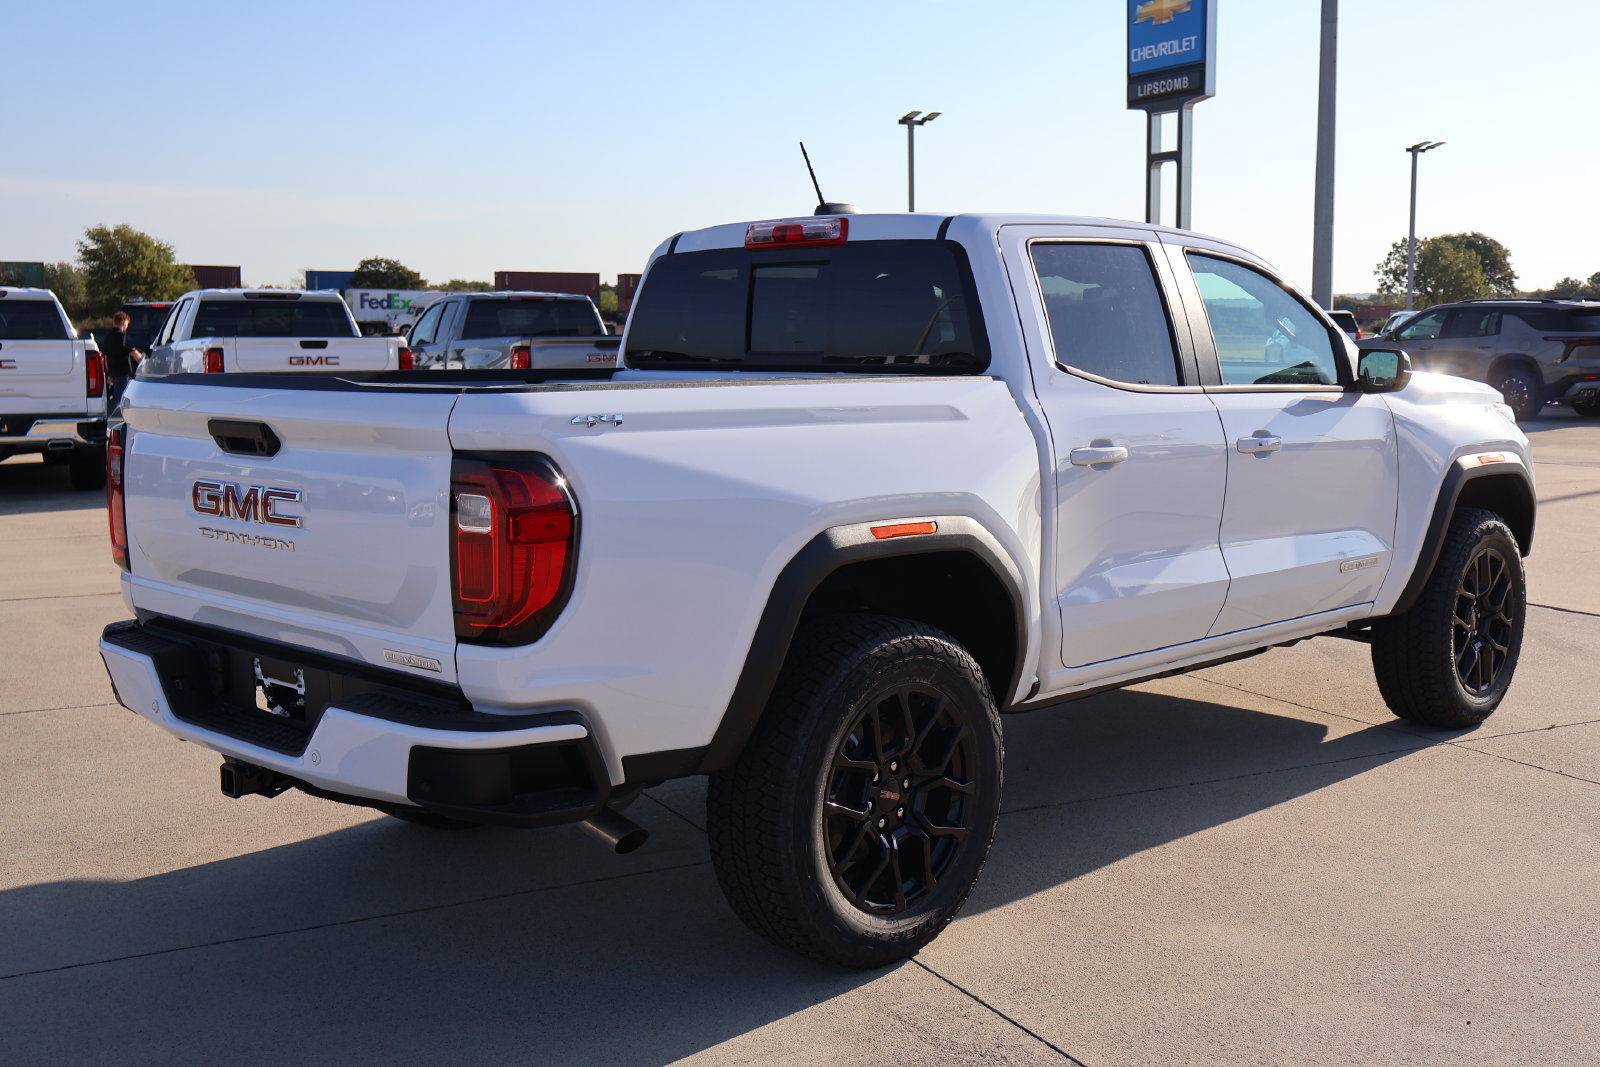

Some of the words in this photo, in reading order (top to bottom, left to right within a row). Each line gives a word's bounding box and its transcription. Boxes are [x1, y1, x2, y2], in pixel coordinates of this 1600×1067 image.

[1130, 35, 1198, 62] CHEVROLET
[1138, 76, 1189, 97] LIPSCOMB
[360, 292, 412, 310] FedEx
[288, 355, 340, 366] GMC
[586, 353, 618, 363] GM
[192, 478, 304, 529] GMC
[198, 527, 296, 552] CANYON
